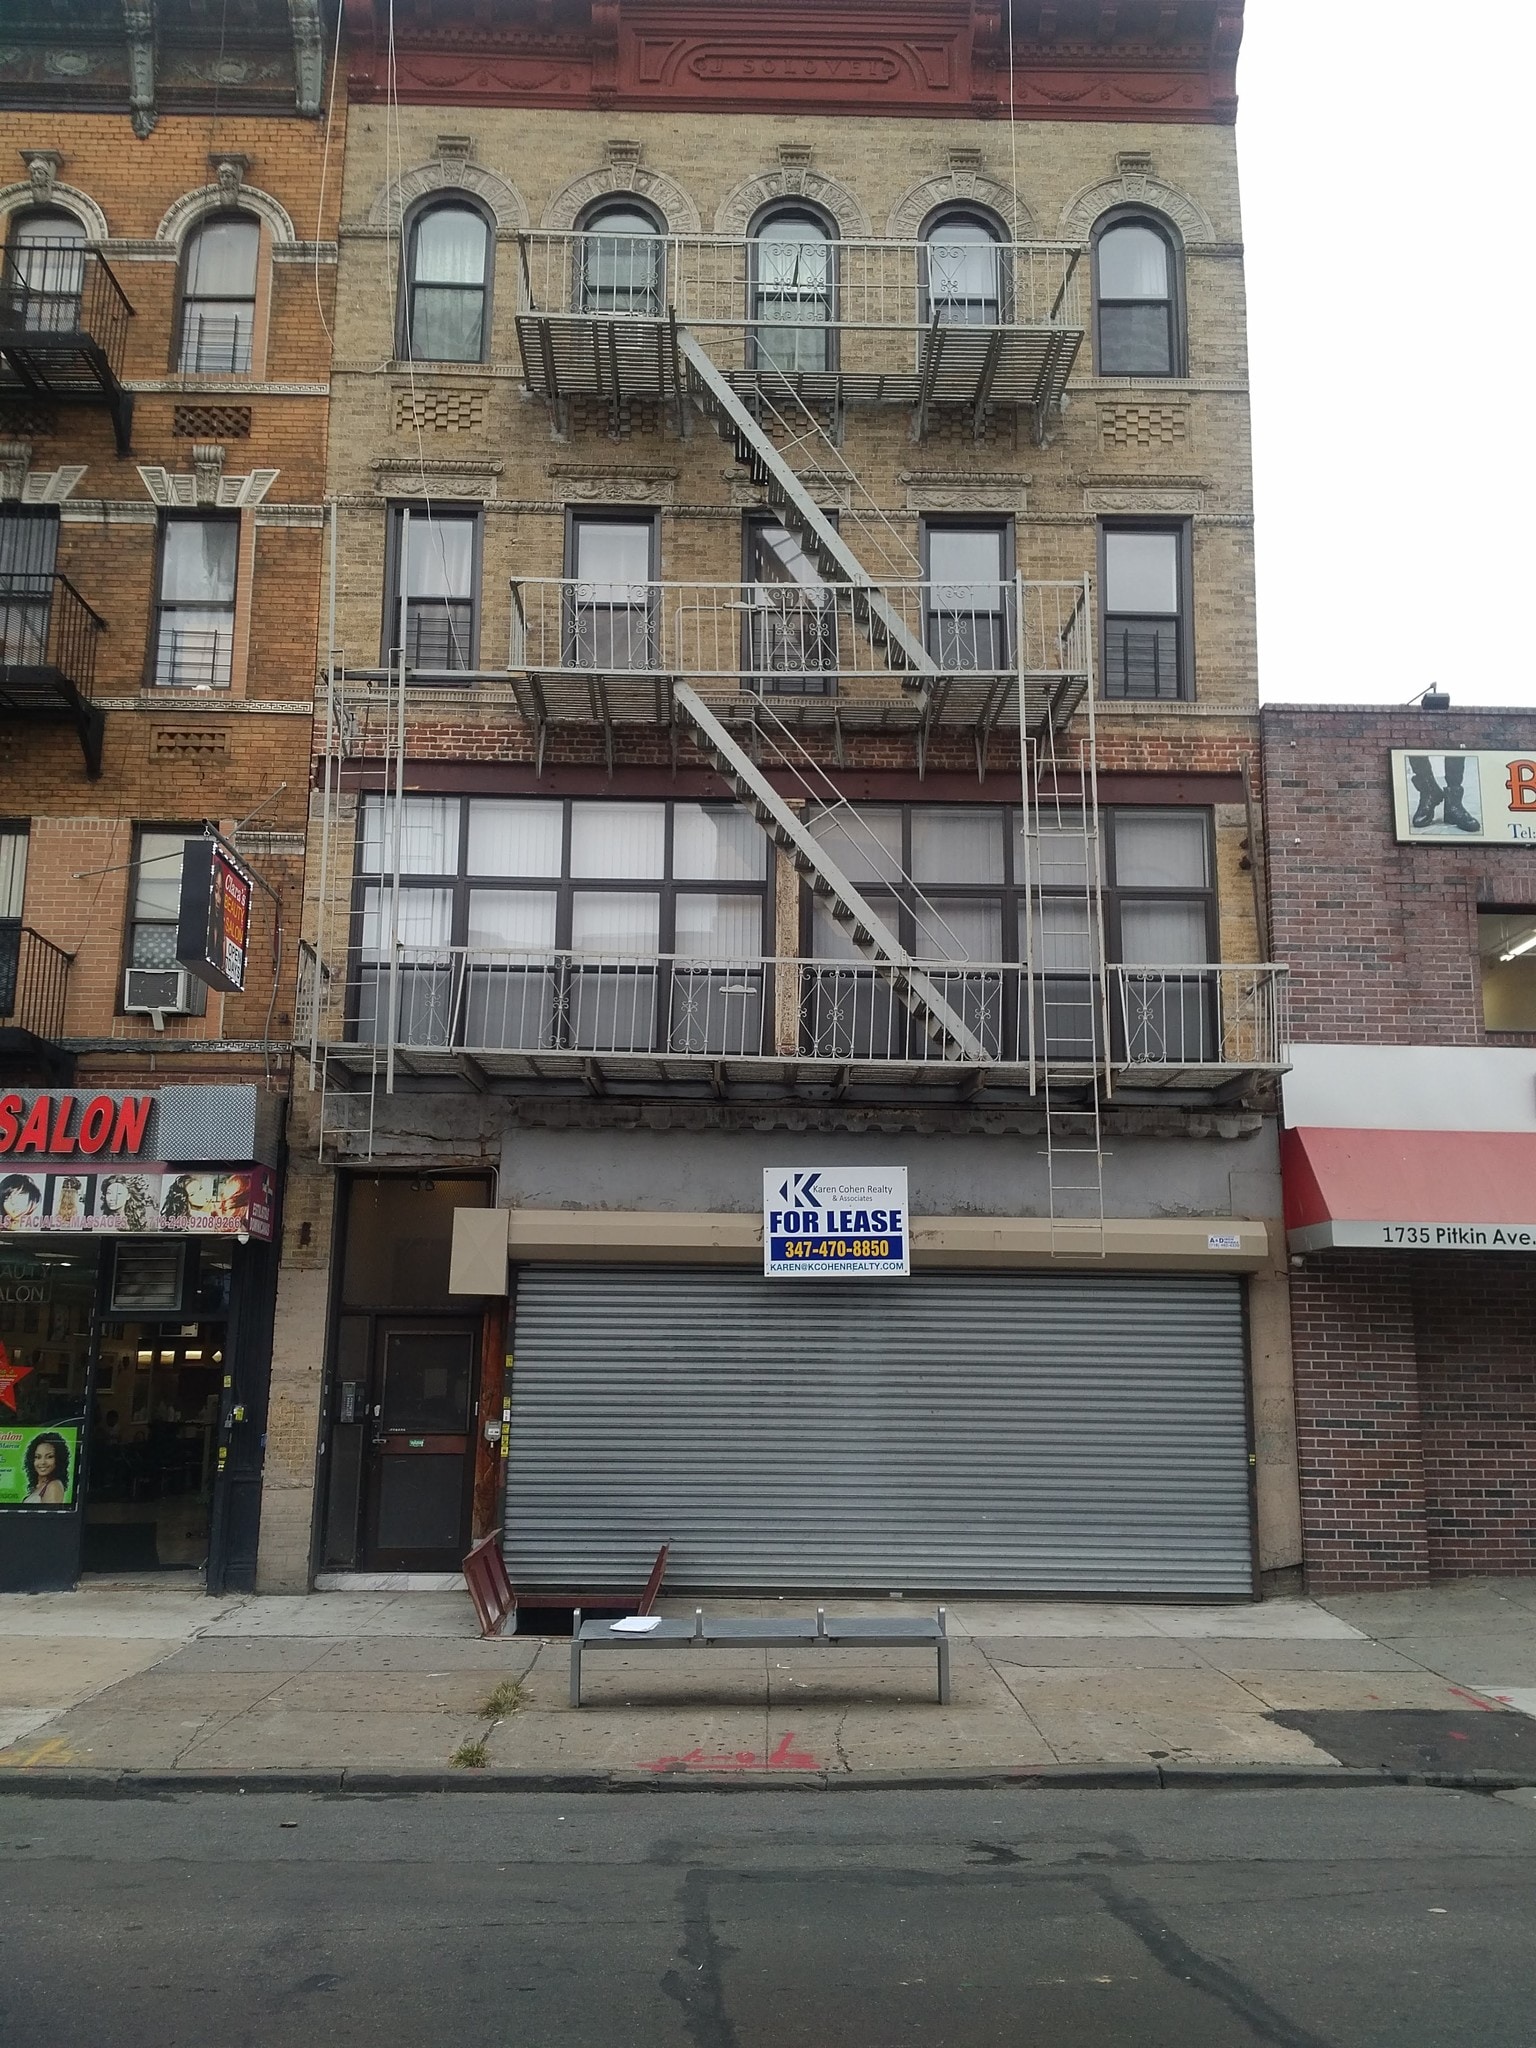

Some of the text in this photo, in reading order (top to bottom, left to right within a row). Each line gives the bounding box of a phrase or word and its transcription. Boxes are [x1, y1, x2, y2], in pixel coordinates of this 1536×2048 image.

[225, 874, 246, 907] Clara's
[224, 893, 246, 924] BEAUTY
[225, 915, 244, 945] SALON
[228, 942, 243, 964] OPEN
[0, 1093, 152, 1154] SALON
[813, 1185, 893, 1195] Karen Cohen Realty
[20, 1215, 61, 1228] FACIALS
[70, 1215, 128, 1229] MASSAGES
[770, 1210, 902, 1233] FOR LEASE
[1383, 1227, 1536, 1246] 1735 Pitkin Ave.
[785, 1240, 889, 1258] 347-470-8850
[770, 1262, 904, 1272] KAREN@KCOHENREALTY.COM
